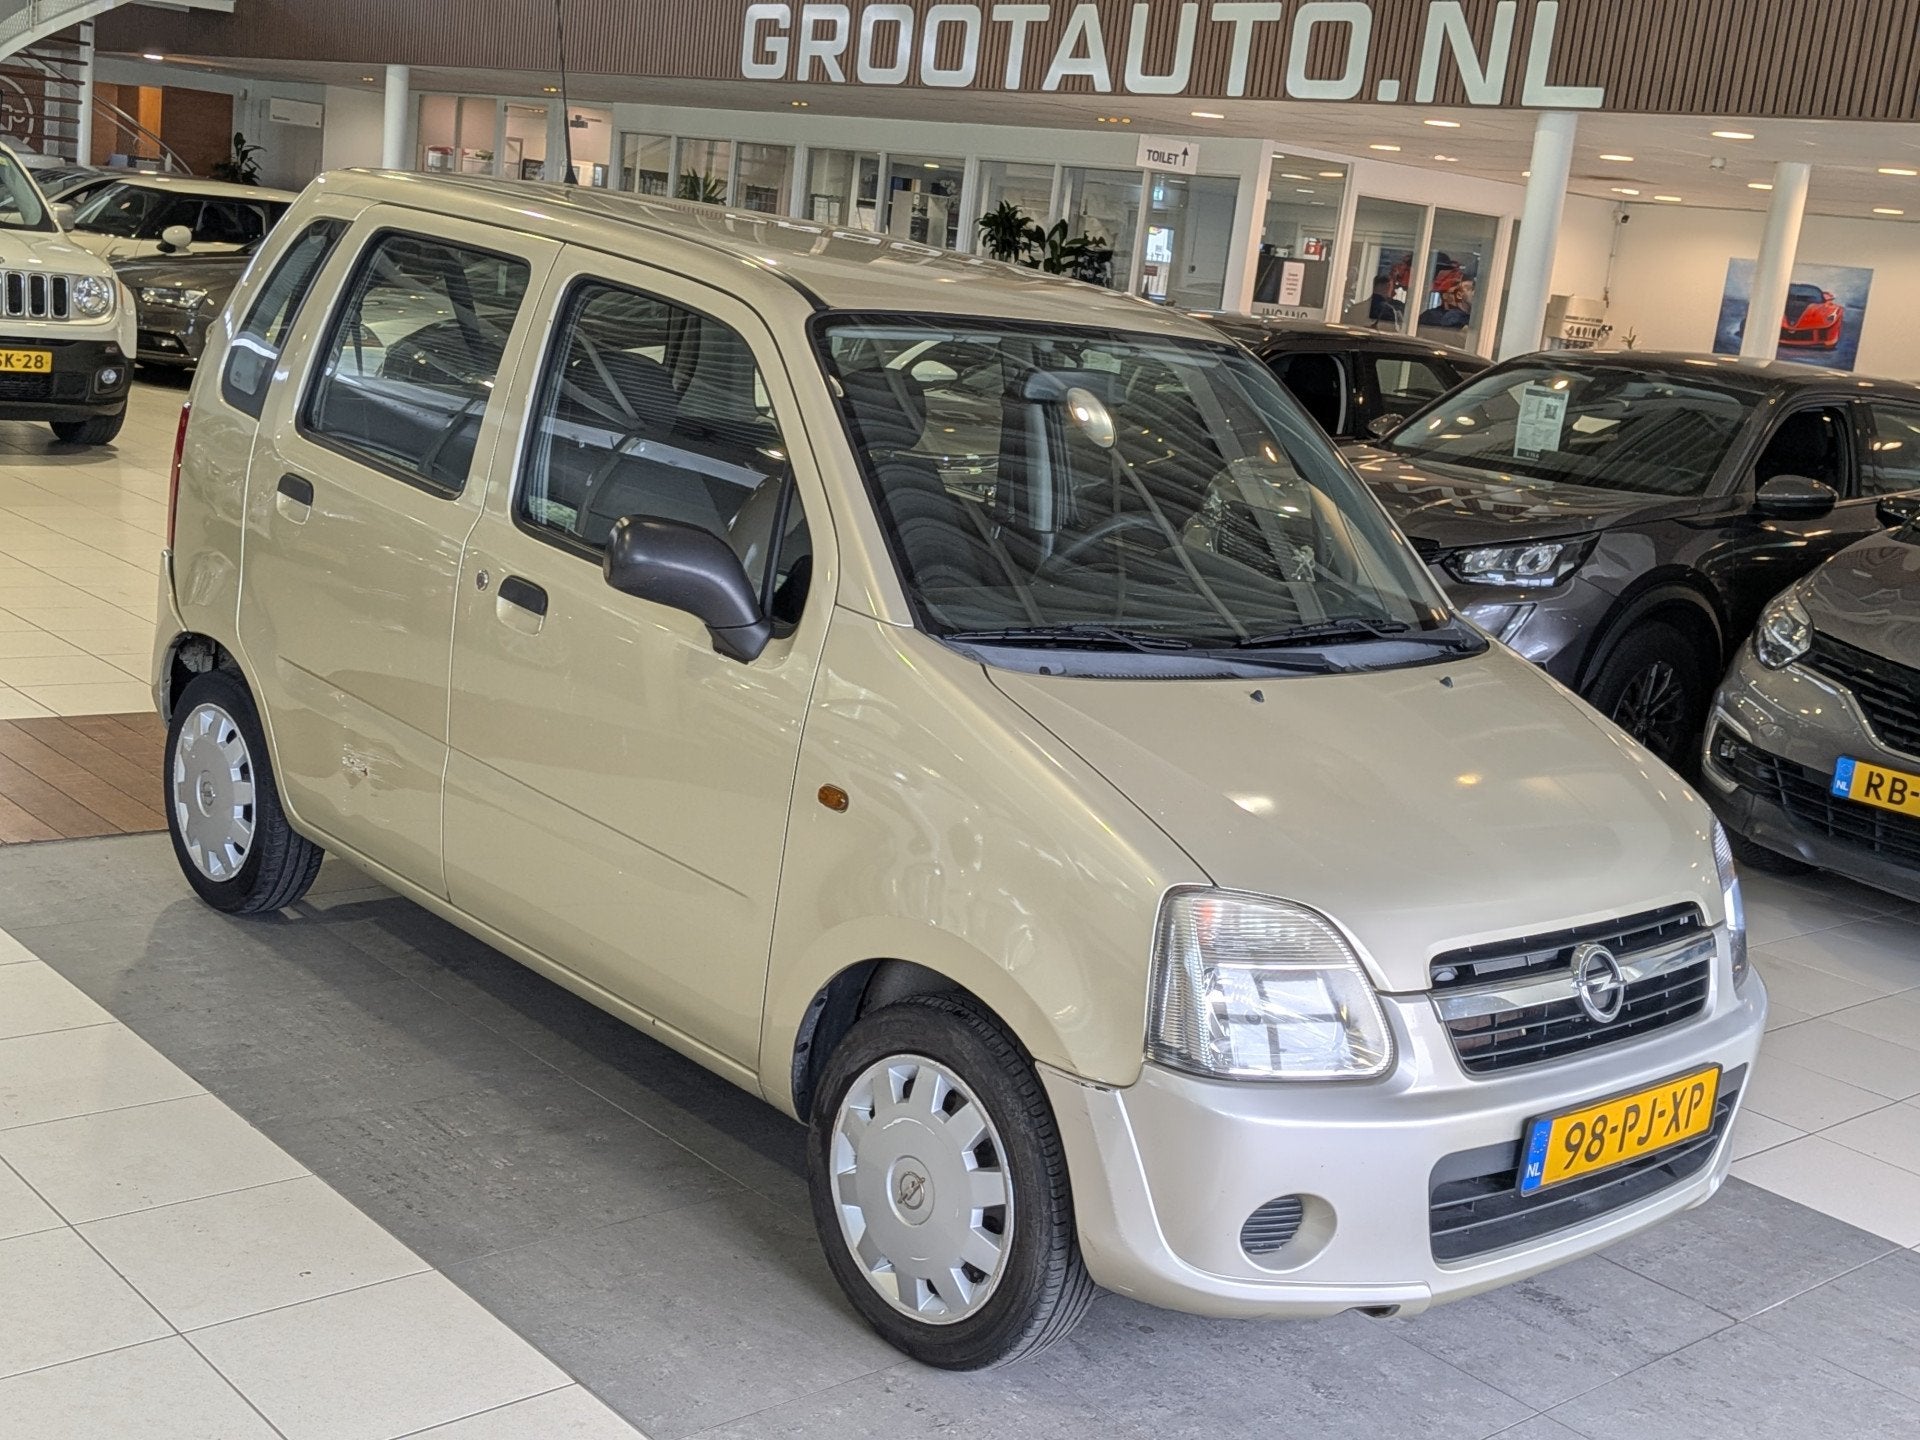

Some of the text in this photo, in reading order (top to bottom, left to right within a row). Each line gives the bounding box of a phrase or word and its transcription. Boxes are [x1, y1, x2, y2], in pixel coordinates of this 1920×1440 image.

[742, 1, 1604, 108] GROOTAUTO.NL
[1147, 149, 1179, 166] TOILET
[0, 353, 44, 369] K-28
[1836, 780, 1848, 791] NL
[1526, 1082, 1705, 1178] NL 98-PJ-XP
